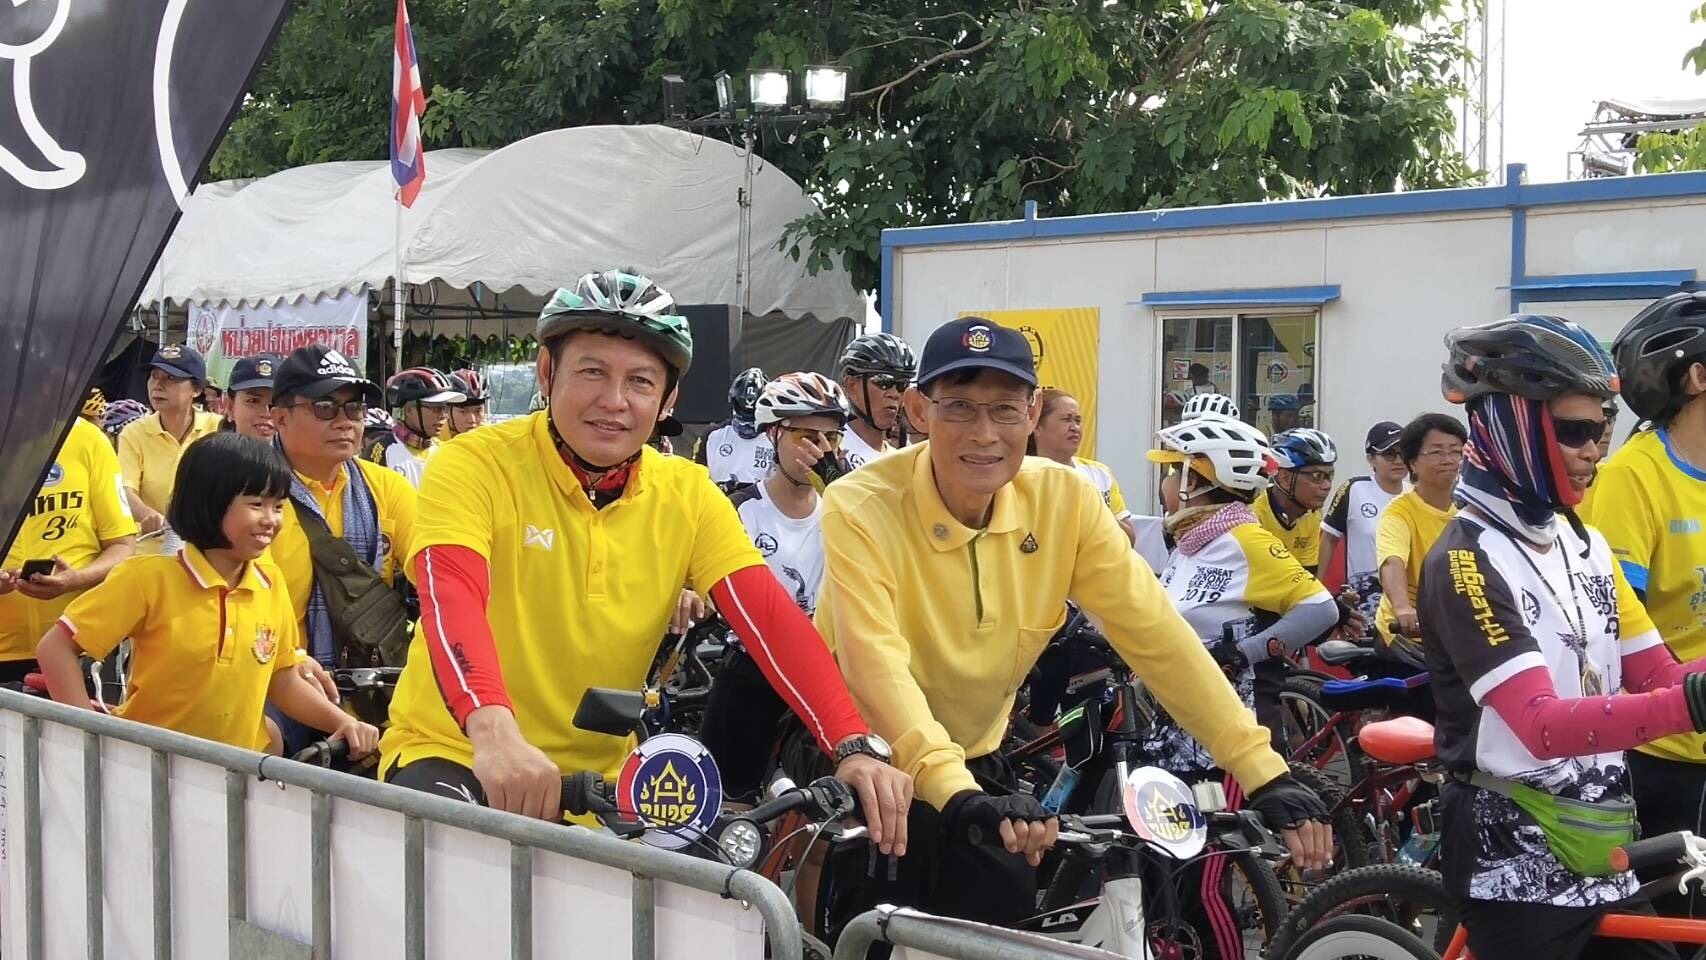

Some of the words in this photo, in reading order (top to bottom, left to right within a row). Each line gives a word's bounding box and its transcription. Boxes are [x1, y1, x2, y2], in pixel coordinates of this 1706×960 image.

[42, 513, 80, 540] 3th
[1206, 567, 1234, 578] GREAT
[1447, 550, 1466, 594] Thailand
[1459, 549, 1510, 647] Tri-League
[1041, 912, 1079, 928] LA
